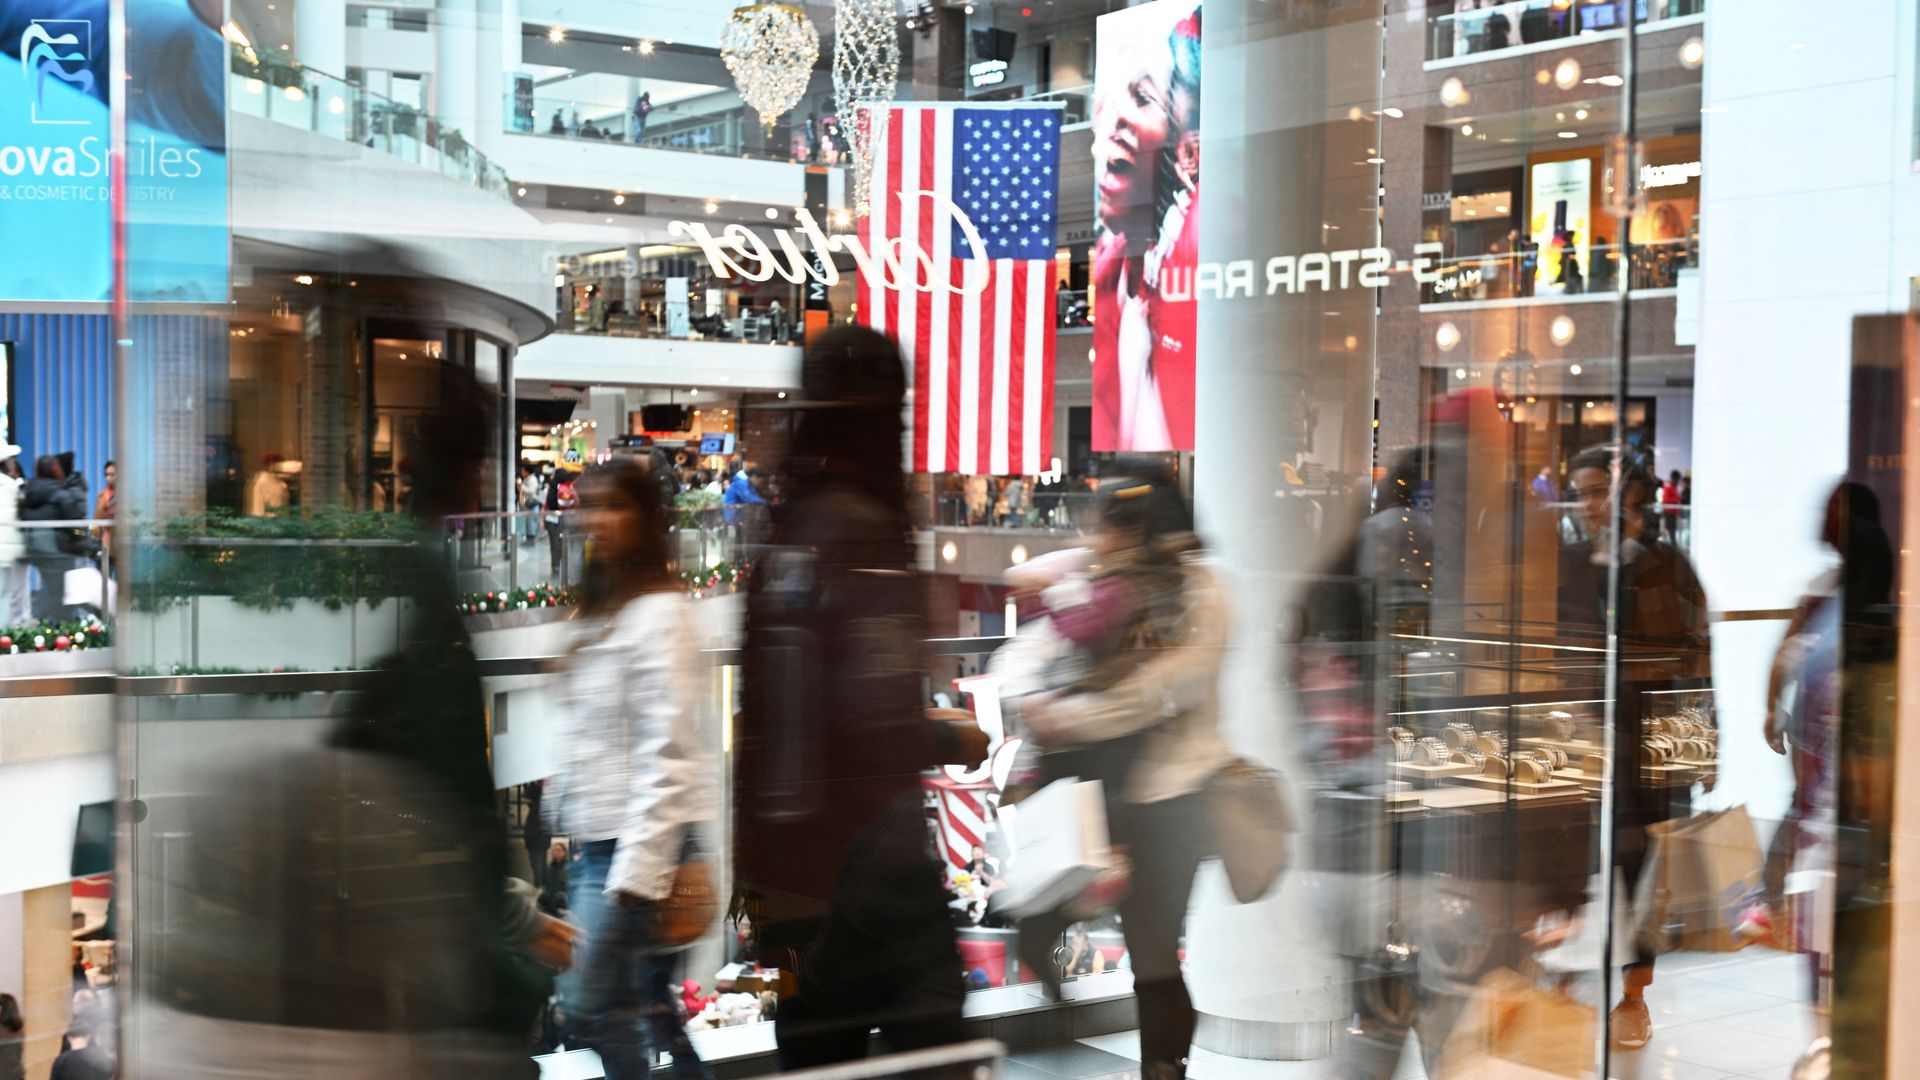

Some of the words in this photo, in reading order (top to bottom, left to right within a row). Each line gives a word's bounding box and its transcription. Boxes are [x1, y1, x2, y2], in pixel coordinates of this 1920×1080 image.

[0, 135, 202, 178] ovaSiles
[1, 186, 12, 200] &
[15, 184, 94, 201] COSMETIC
[98, 185, 176, 201] DEISTRY
